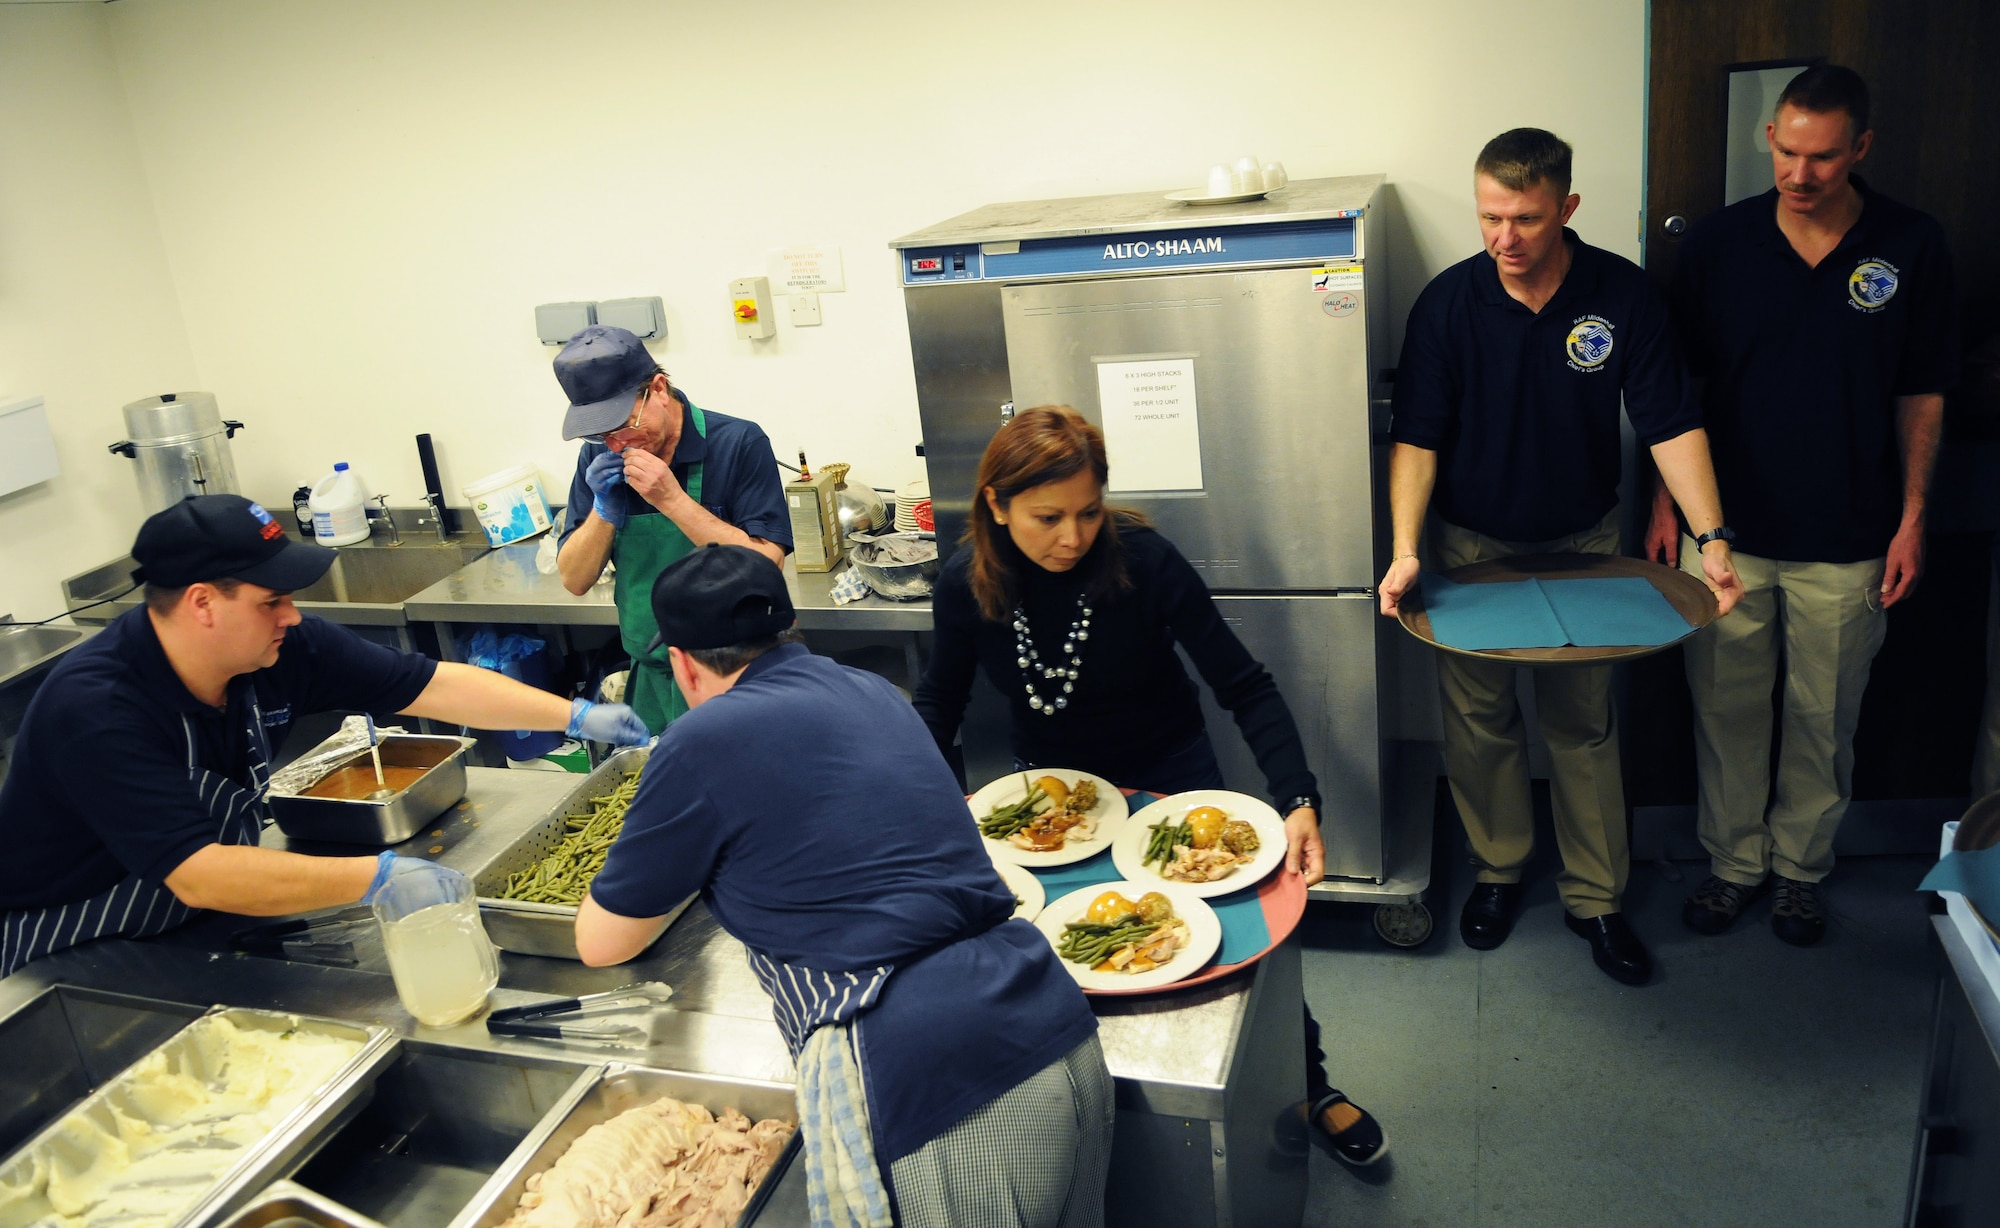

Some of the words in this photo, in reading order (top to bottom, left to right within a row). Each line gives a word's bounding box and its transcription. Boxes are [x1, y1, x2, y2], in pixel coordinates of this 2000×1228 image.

[920, 259, 936, 269] 142
[1324, 298, 1340, 307] HALO
[1573, 315, 1586, 325] RAF
[1567, 360, 1585, 372] Chief's
